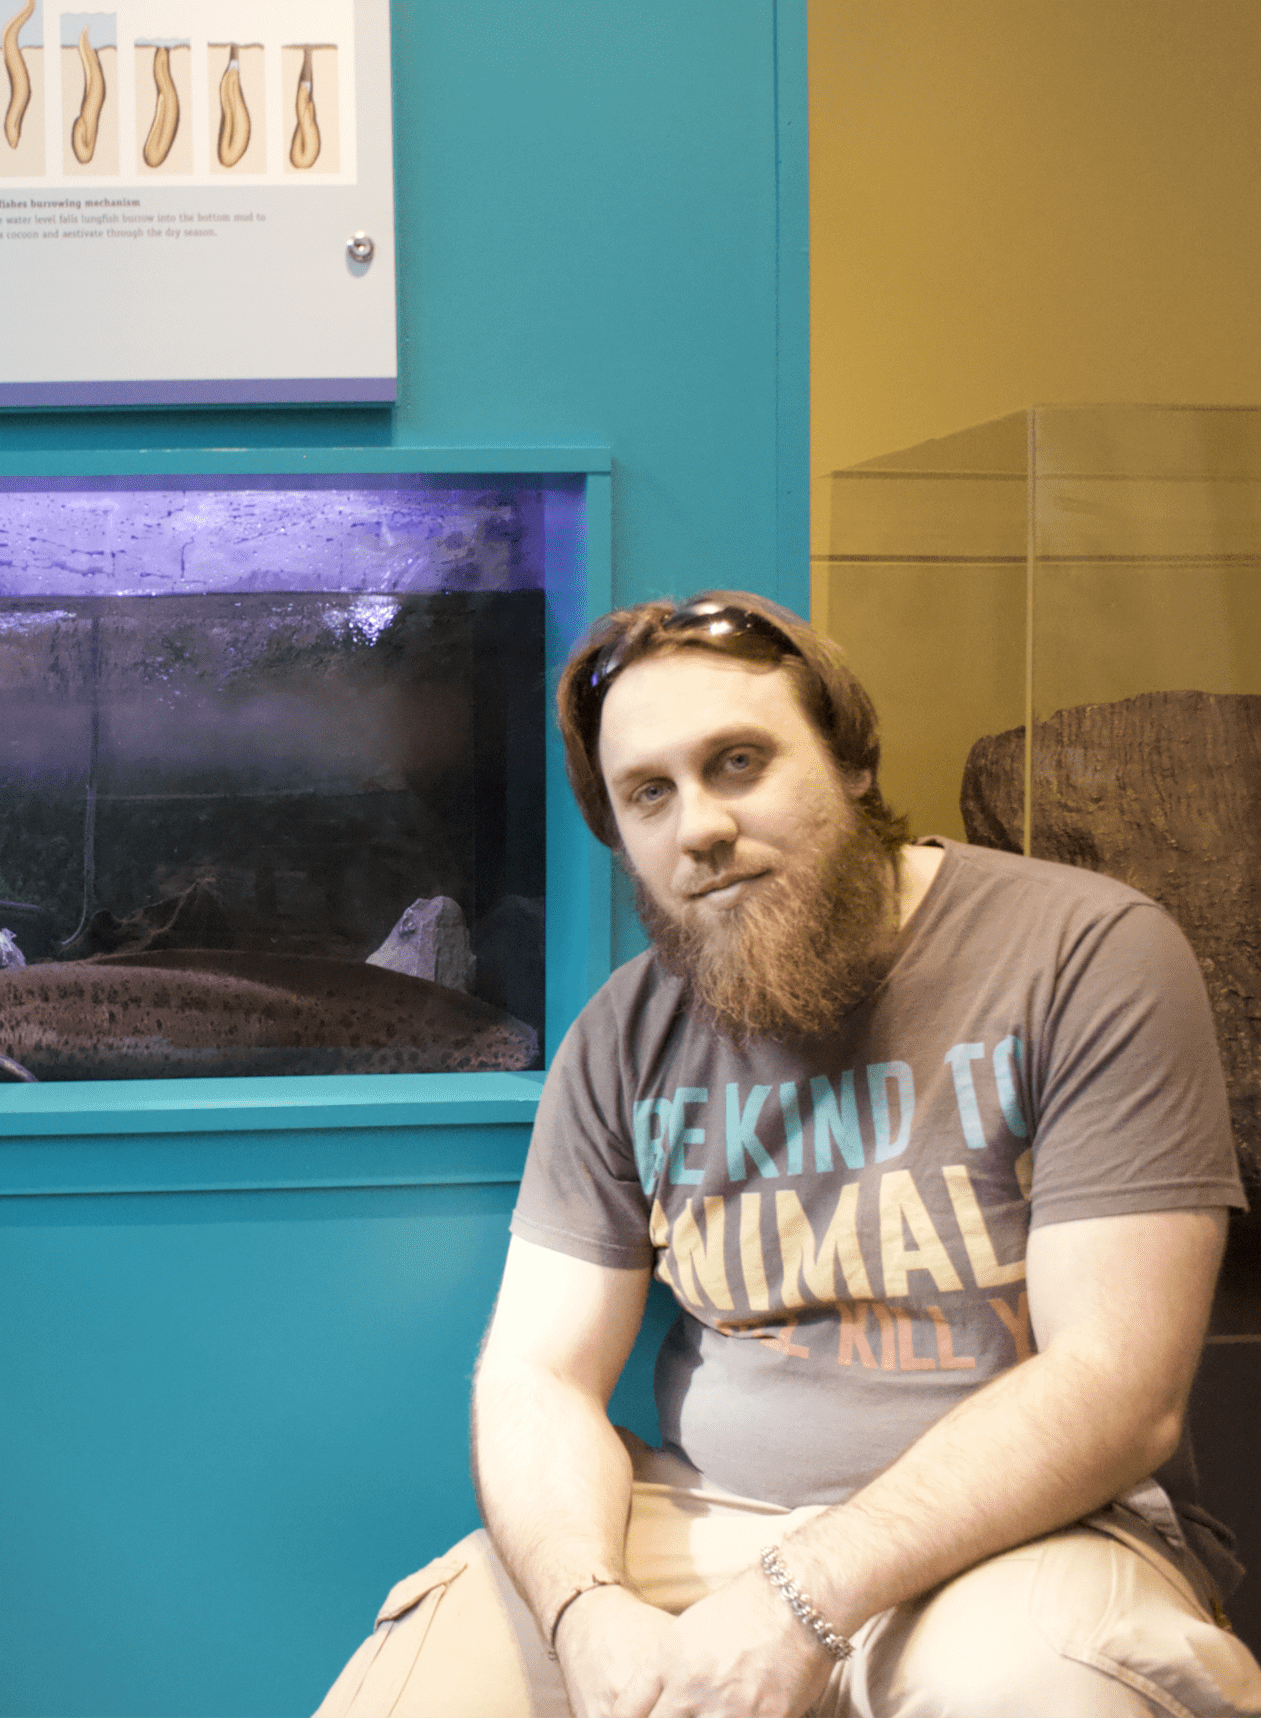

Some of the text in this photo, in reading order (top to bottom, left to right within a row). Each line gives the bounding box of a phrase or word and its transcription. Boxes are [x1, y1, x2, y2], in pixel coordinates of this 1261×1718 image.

[7, 231, 39, 239] cocoon
[43, 228, 59, 239] and
[63, 228, 104, 239] aestivate
[106, 227, 143, 242] through
[147, 227, 162, 238] the
[165, 227, 181, 241] dry
[30, 198, 81, 212] burrowing
[85, 197, 139, 209] mechanism
[725, 1060, 915, 1182] KIND
[650, 1147, 1033, 1311] NIMAL
[837, 1302, 975, 1371] KILL
